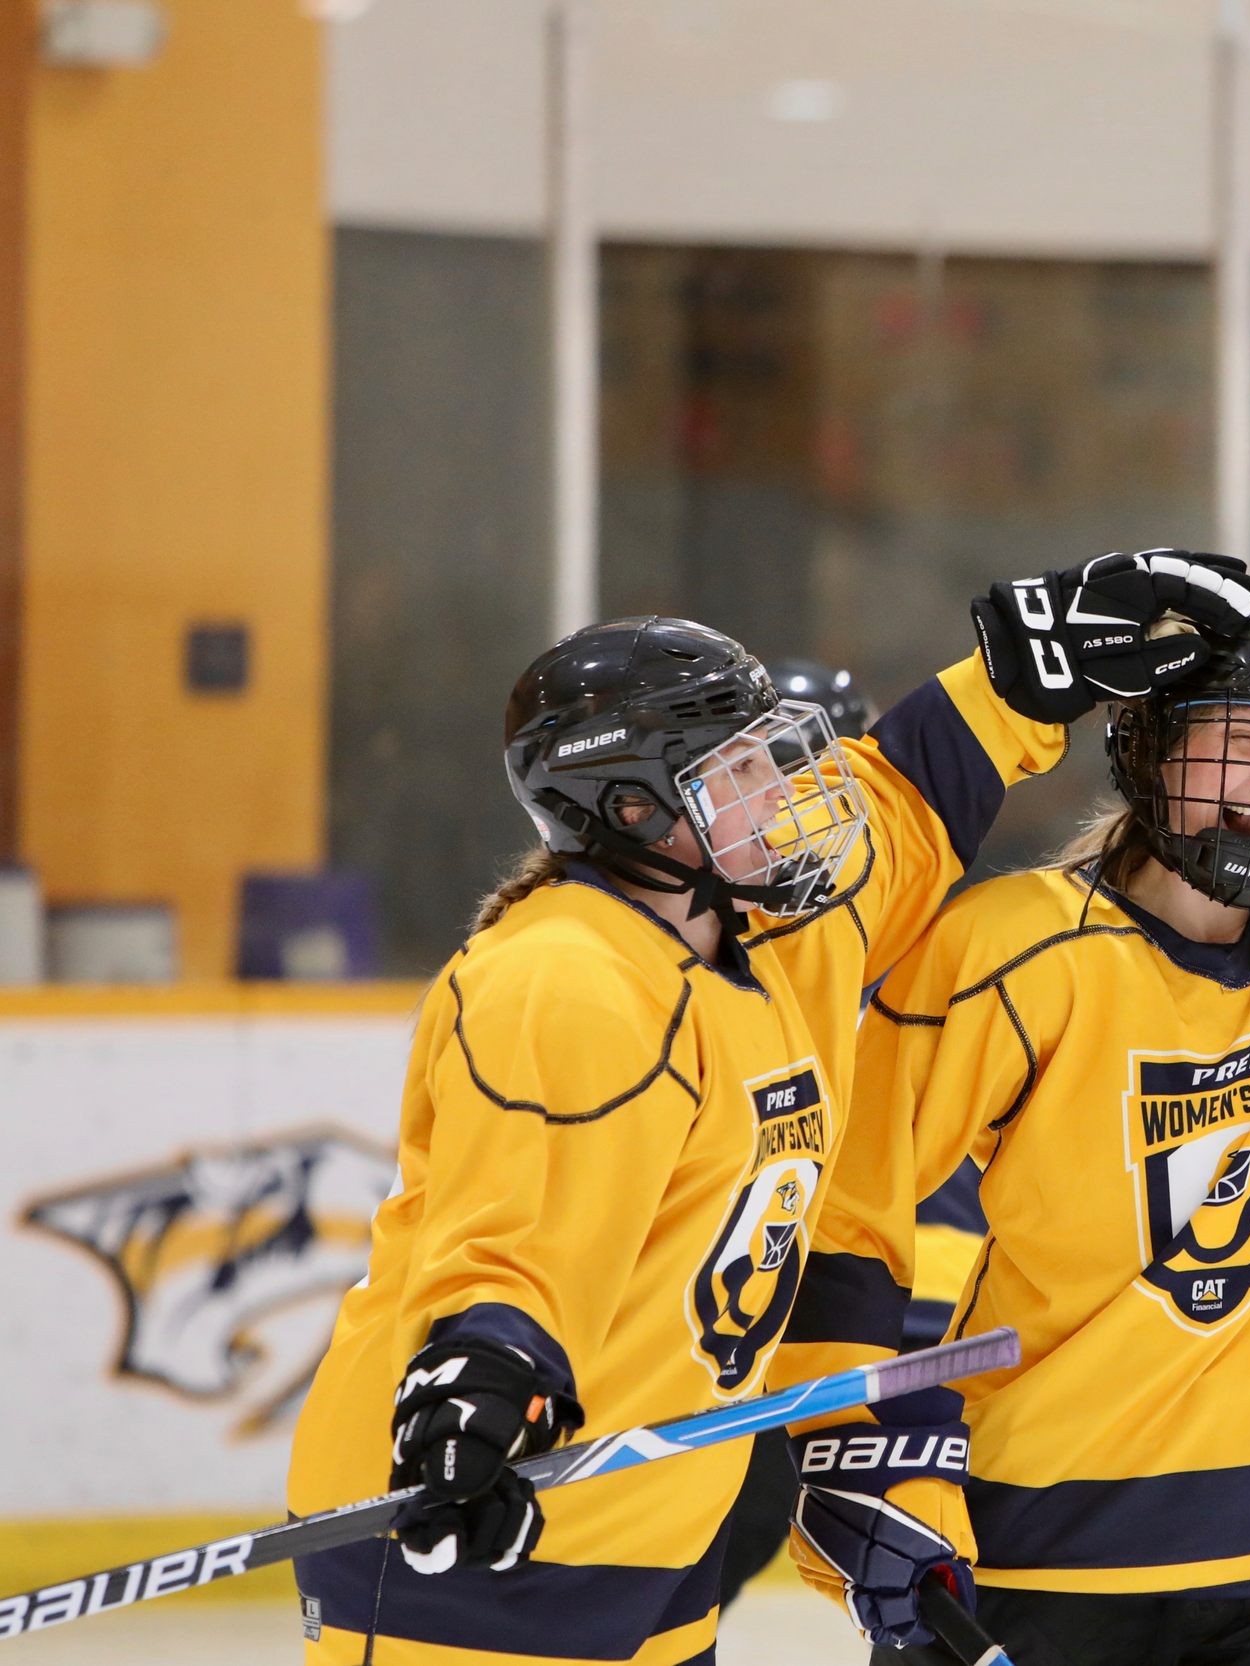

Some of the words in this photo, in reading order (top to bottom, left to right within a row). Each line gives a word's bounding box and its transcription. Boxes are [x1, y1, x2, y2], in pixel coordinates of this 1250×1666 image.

[1083, 639, 1103, 649] AS
[1105, 635, 1134, 645] 580
[1155, 651, 1196, 675] CCM
[1191, 1278, 1226, 1301] CAT
[1192, 1301, 1223, 1312] Financial
[444, 1438, 457, 1482] CCM
[801, 1435, 971, 1473] BAUE
